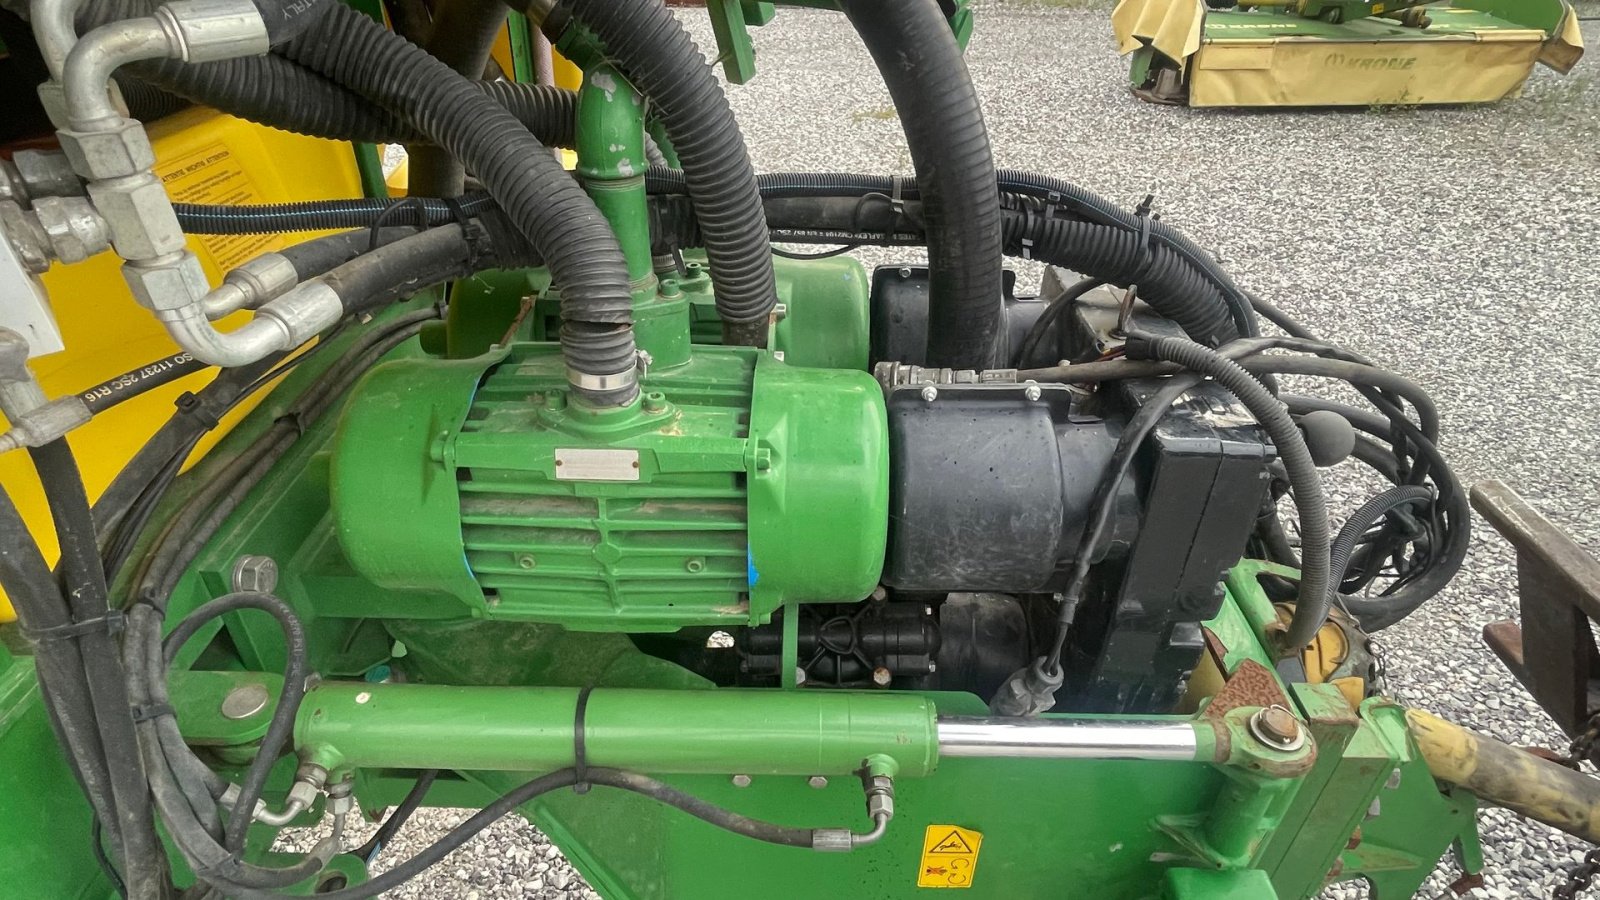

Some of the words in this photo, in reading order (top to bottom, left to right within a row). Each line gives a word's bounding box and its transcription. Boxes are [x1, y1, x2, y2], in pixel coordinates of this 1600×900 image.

[281, 0, 315, 20] TALY
[1347, 57, 1417, 71] KRONE
[174, 352, 193, 365] SO
[140, 360, 174, 379] 11237
[111, 374, 139, 390] 2SC
[85, 385, 112, 402] R16
